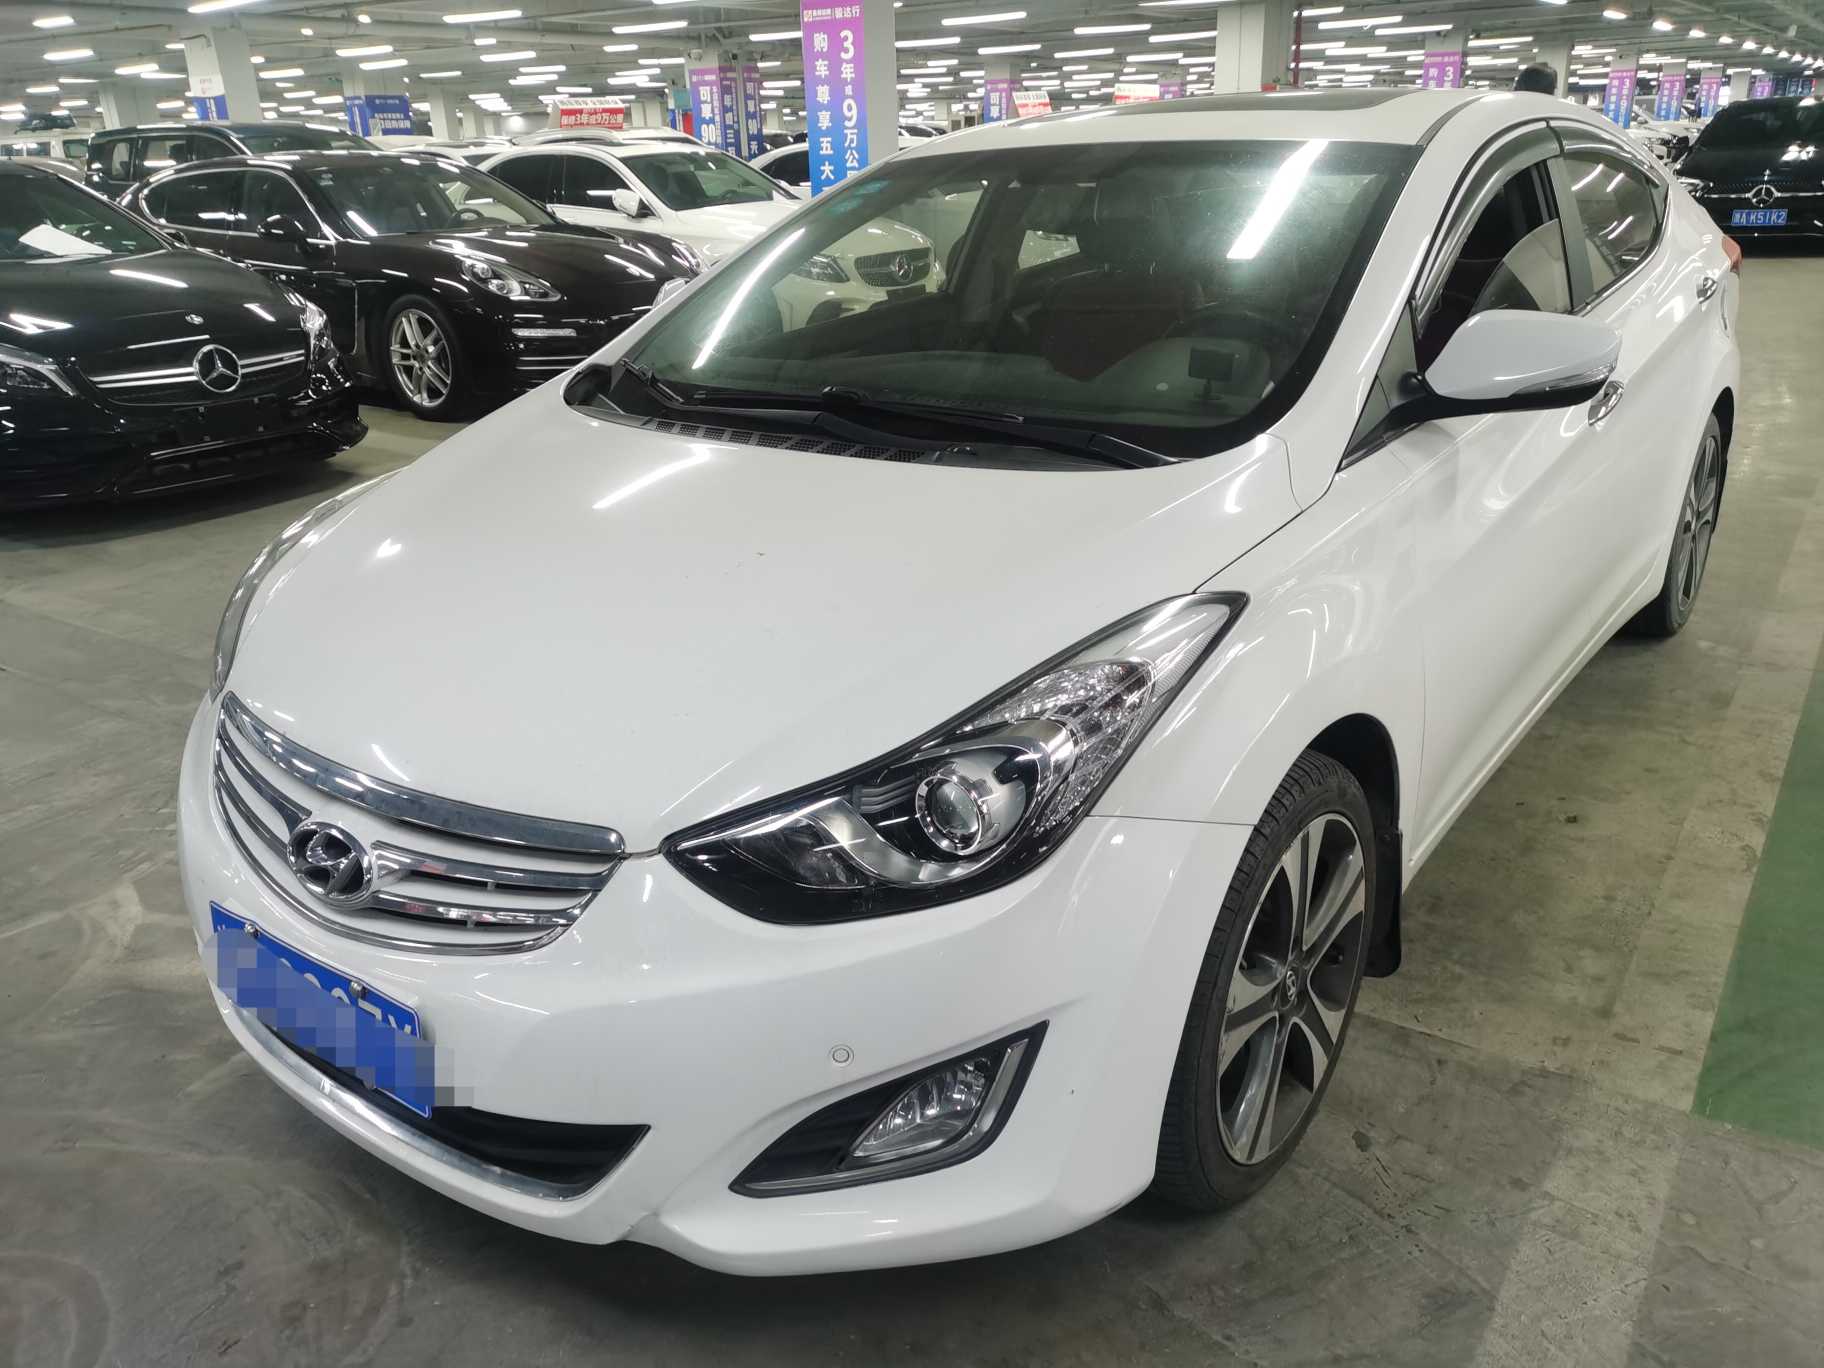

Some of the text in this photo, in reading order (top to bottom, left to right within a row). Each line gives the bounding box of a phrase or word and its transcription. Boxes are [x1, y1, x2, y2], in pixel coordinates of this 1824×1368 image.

[699, 86, 717, 150] 可享90
[813, 32, 835, 192] 购车尊享五大
